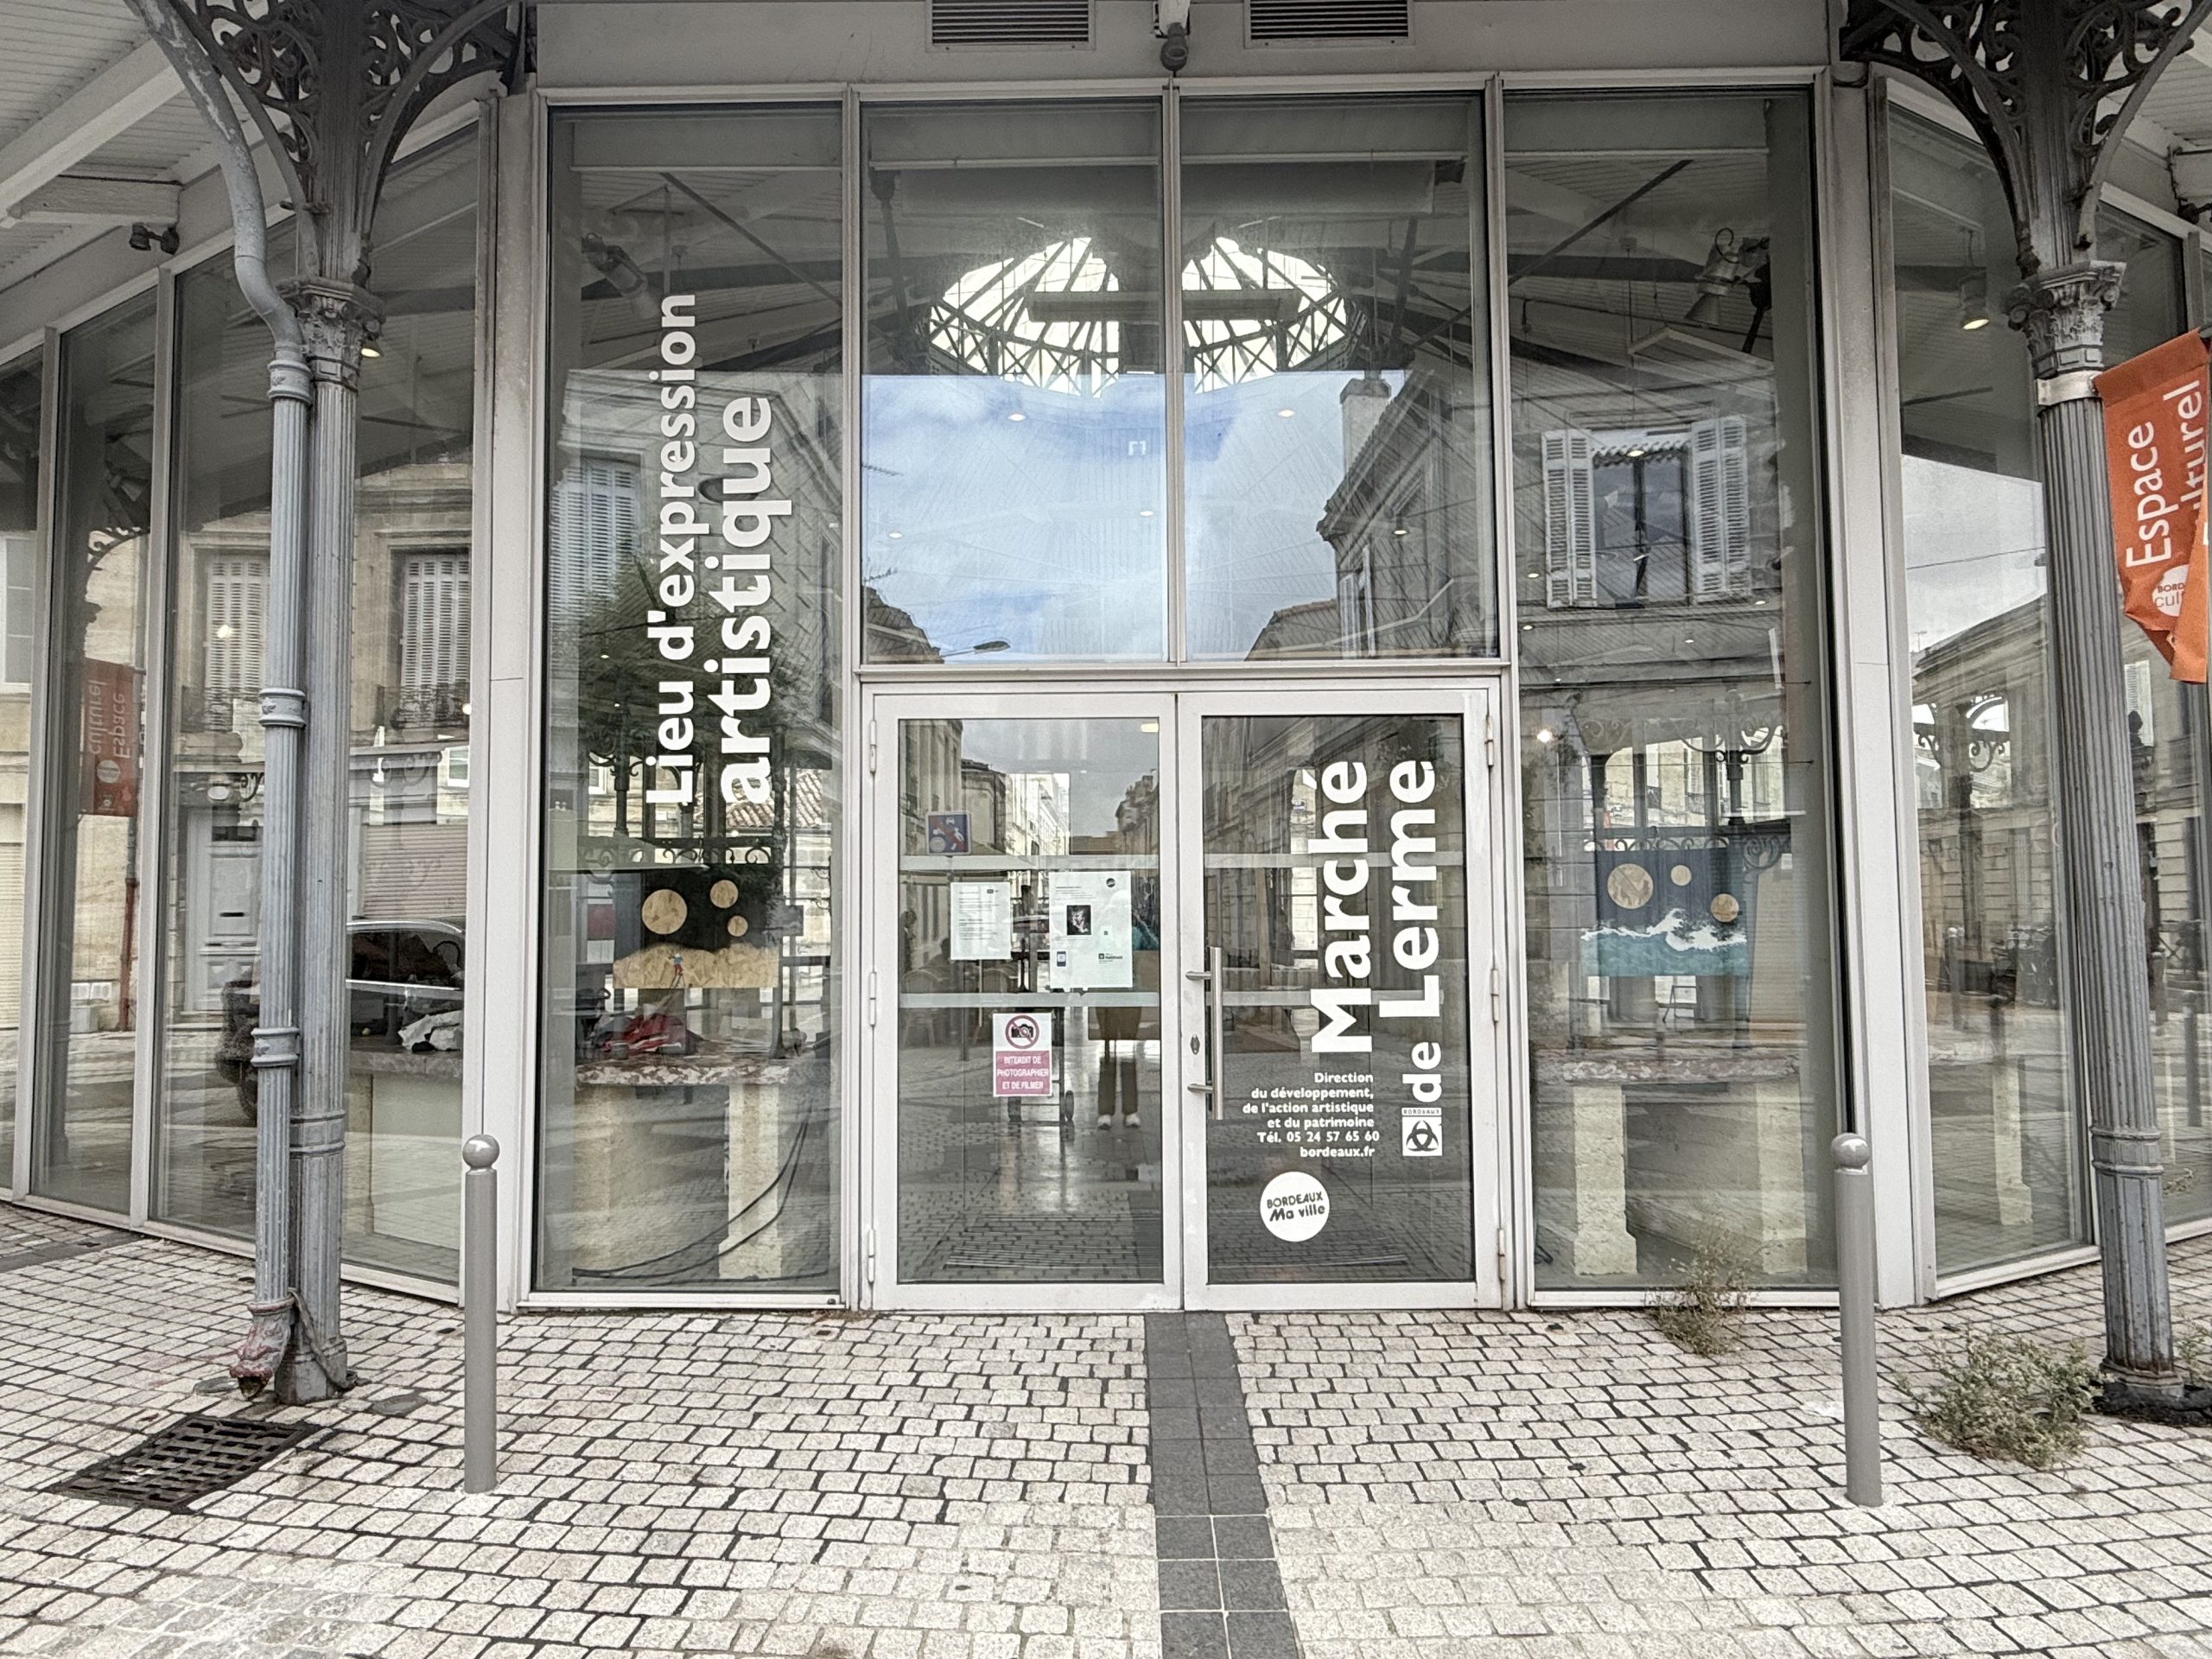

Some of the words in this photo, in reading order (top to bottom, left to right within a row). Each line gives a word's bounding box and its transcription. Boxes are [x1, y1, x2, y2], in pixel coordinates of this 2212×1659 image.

[2163, 380, 2204, 510] lturel
[647, 294, 709, 661] d'expression
[2126, 421, 2179, 569] Espace
[2157, 582, 2185, 594] BORD
[704, 396, 792, 804] artistique
[646, 681, 694, 804] Lieu
[1379, 760, 1441, 1018] Lerme
[1301, 760, 1373, 1053] Marché
[1003, 1056, 1032, 1065] INTERDIT
[1033, 1056, 1042, 1065] DE
[996, 1068, 1049, 1077] PHOTOGRAPHIER
[1313, 1071, 1374, 1083] Direction
[1403, 1041, 1442, 1103] de
[1002, 1081, 1010, 1090] ET
[1011, 1081, 1020, 1090] DE
[1020, 1081, 1044, 1090] FILMER
[1251, 1088, 1268, 1098] du
[1270, 1087, 1374, 1101] développement,
[1243, 1103, 1258, 1113] de
[1261, 1102, 1308, 1113] l'action
[1312, 1102, 1374, 1115] artistique
[1267, 1118, 1281, 1128] et
[1284, 1116, 1300, 1128] du
[1304, 1116, 1375, 1130] patrimoine
[1256, 1131, 1281, 1143] Tél.
[1286, 1131, 1301, 1142] 05
[1306, 1131, 1321, 1142] 24
[1325, 1131, 1340, 1142] 57
[1345, 1130, 1359, 1141] 65
[1364, 1130, 1380, 1141] 60
[1300, 1146, 1375, 1157] bordeaux.fr
[1267, 1191, 1324, 1209] BORDEAUX
[1269, 1207, 1294, 1222] Ma
[1298, 1204, 1325, 1217] ville
